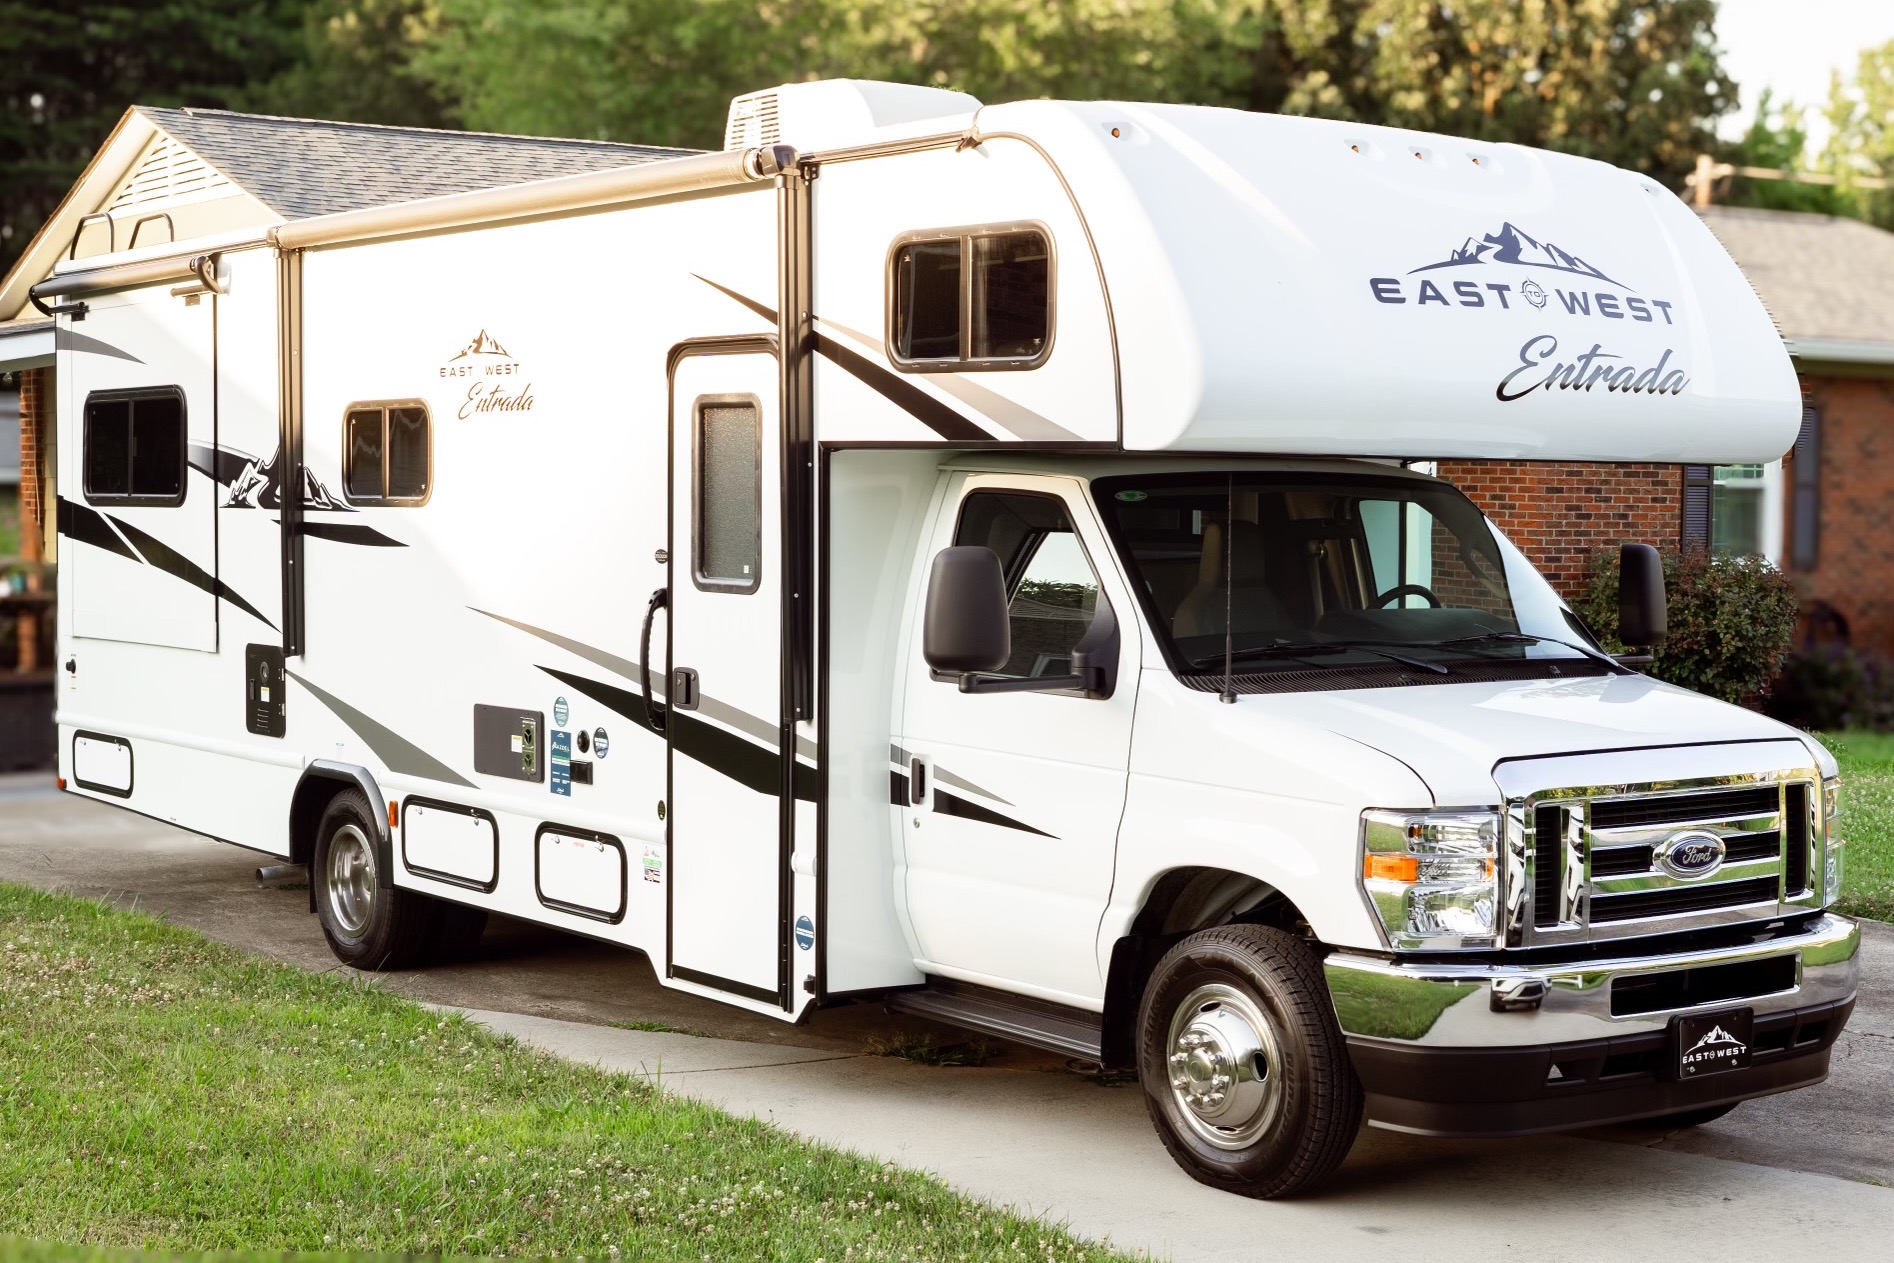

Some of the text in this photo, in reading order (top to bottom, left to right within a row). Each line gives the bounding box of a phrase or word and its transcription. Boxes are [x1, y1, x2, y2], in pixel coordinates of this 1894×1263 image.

[1369, 277, 1673, 325] EAST TO WEST
[440, 364, 519, 377] EAST WEST
[1496, 334, 1690, 402] Entrada
[458, 381, 534, 420] Entrada
[1682, 844, 1712, 865] Ford
[1682, 1052, 1709, 1064] EAST
[1716, 1046, 1747, 1058] WEST
